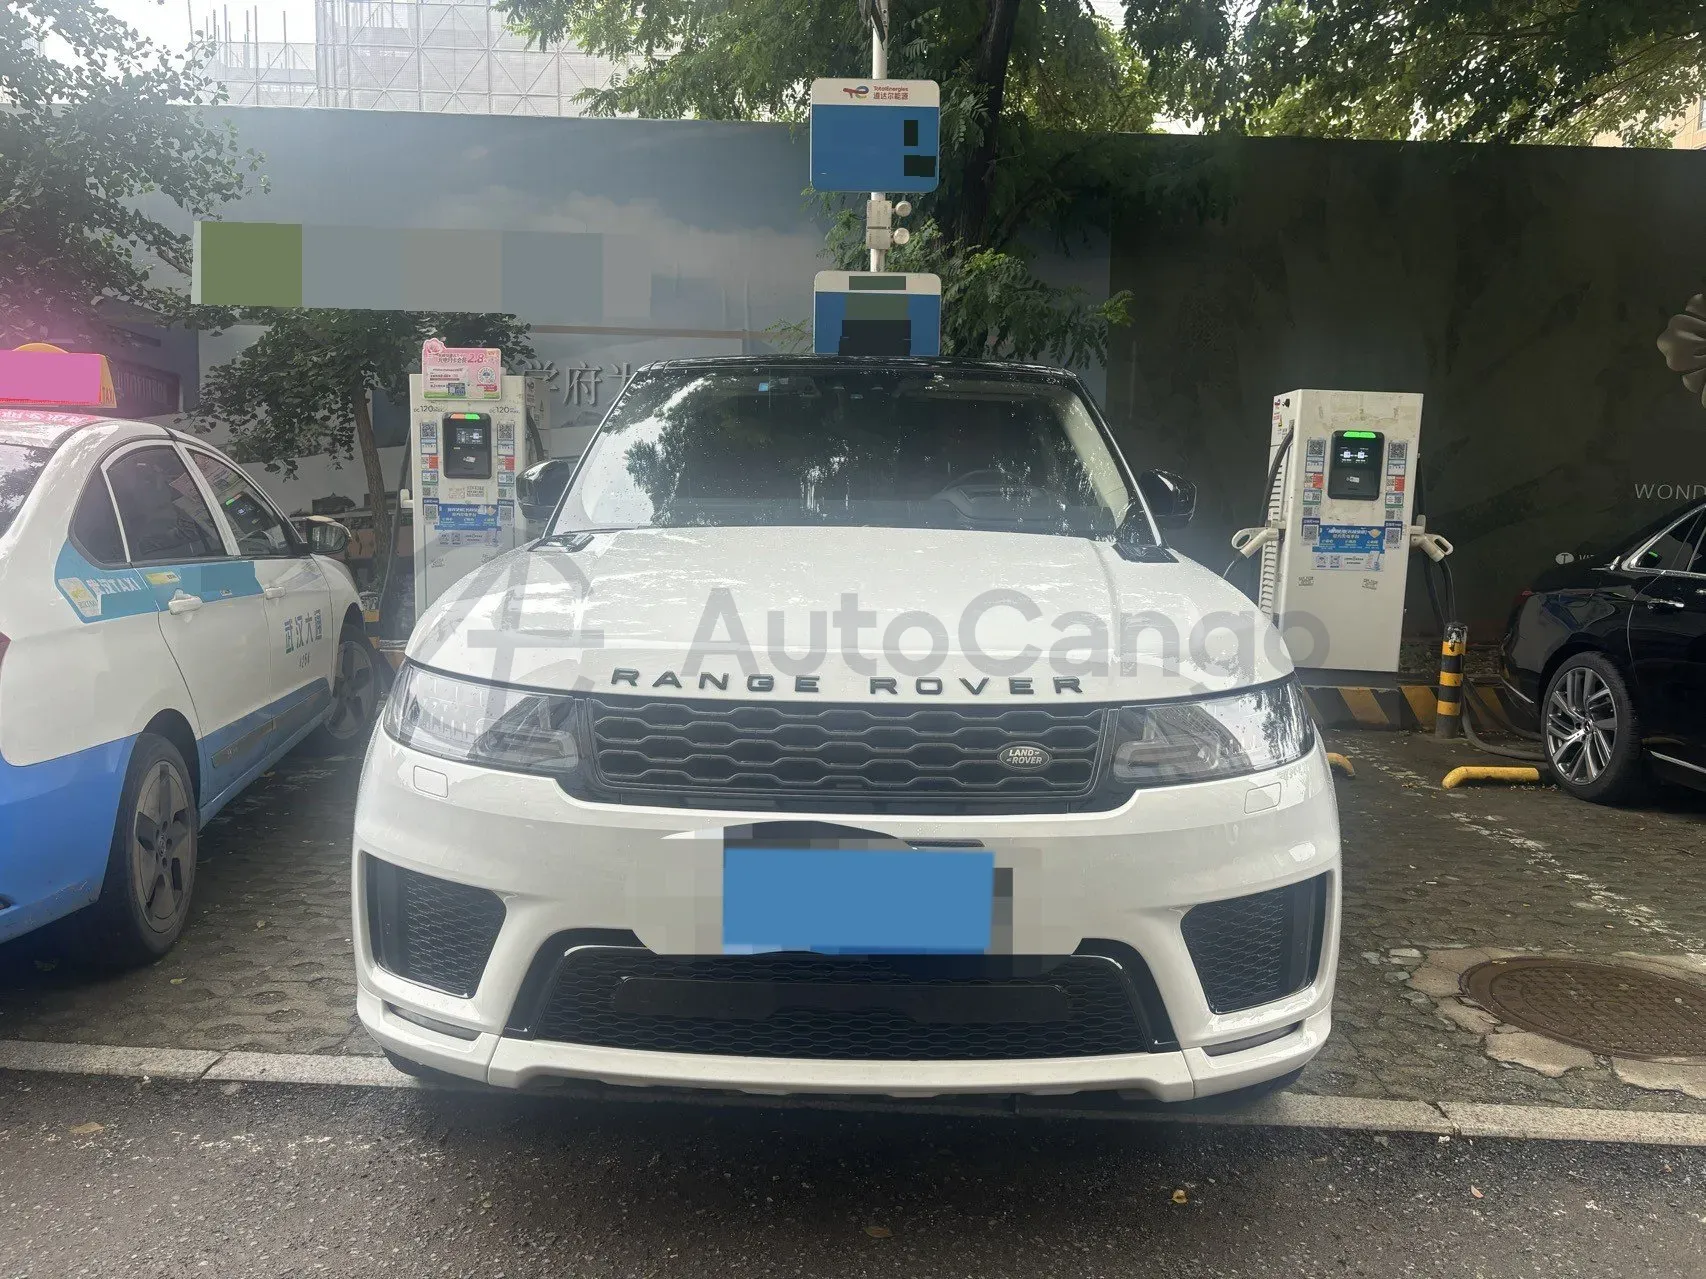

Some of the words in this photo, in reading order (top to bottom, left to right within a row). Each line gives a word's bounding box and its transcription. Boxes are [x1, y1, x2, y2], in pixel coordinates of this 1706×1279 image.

[610, 666, 821, 693] RANGE
[869, 676, 1083, 696] ROVER
[1009, 749, 1034, 757] LAND
[1011, 756, 1043, 764] ROVER
